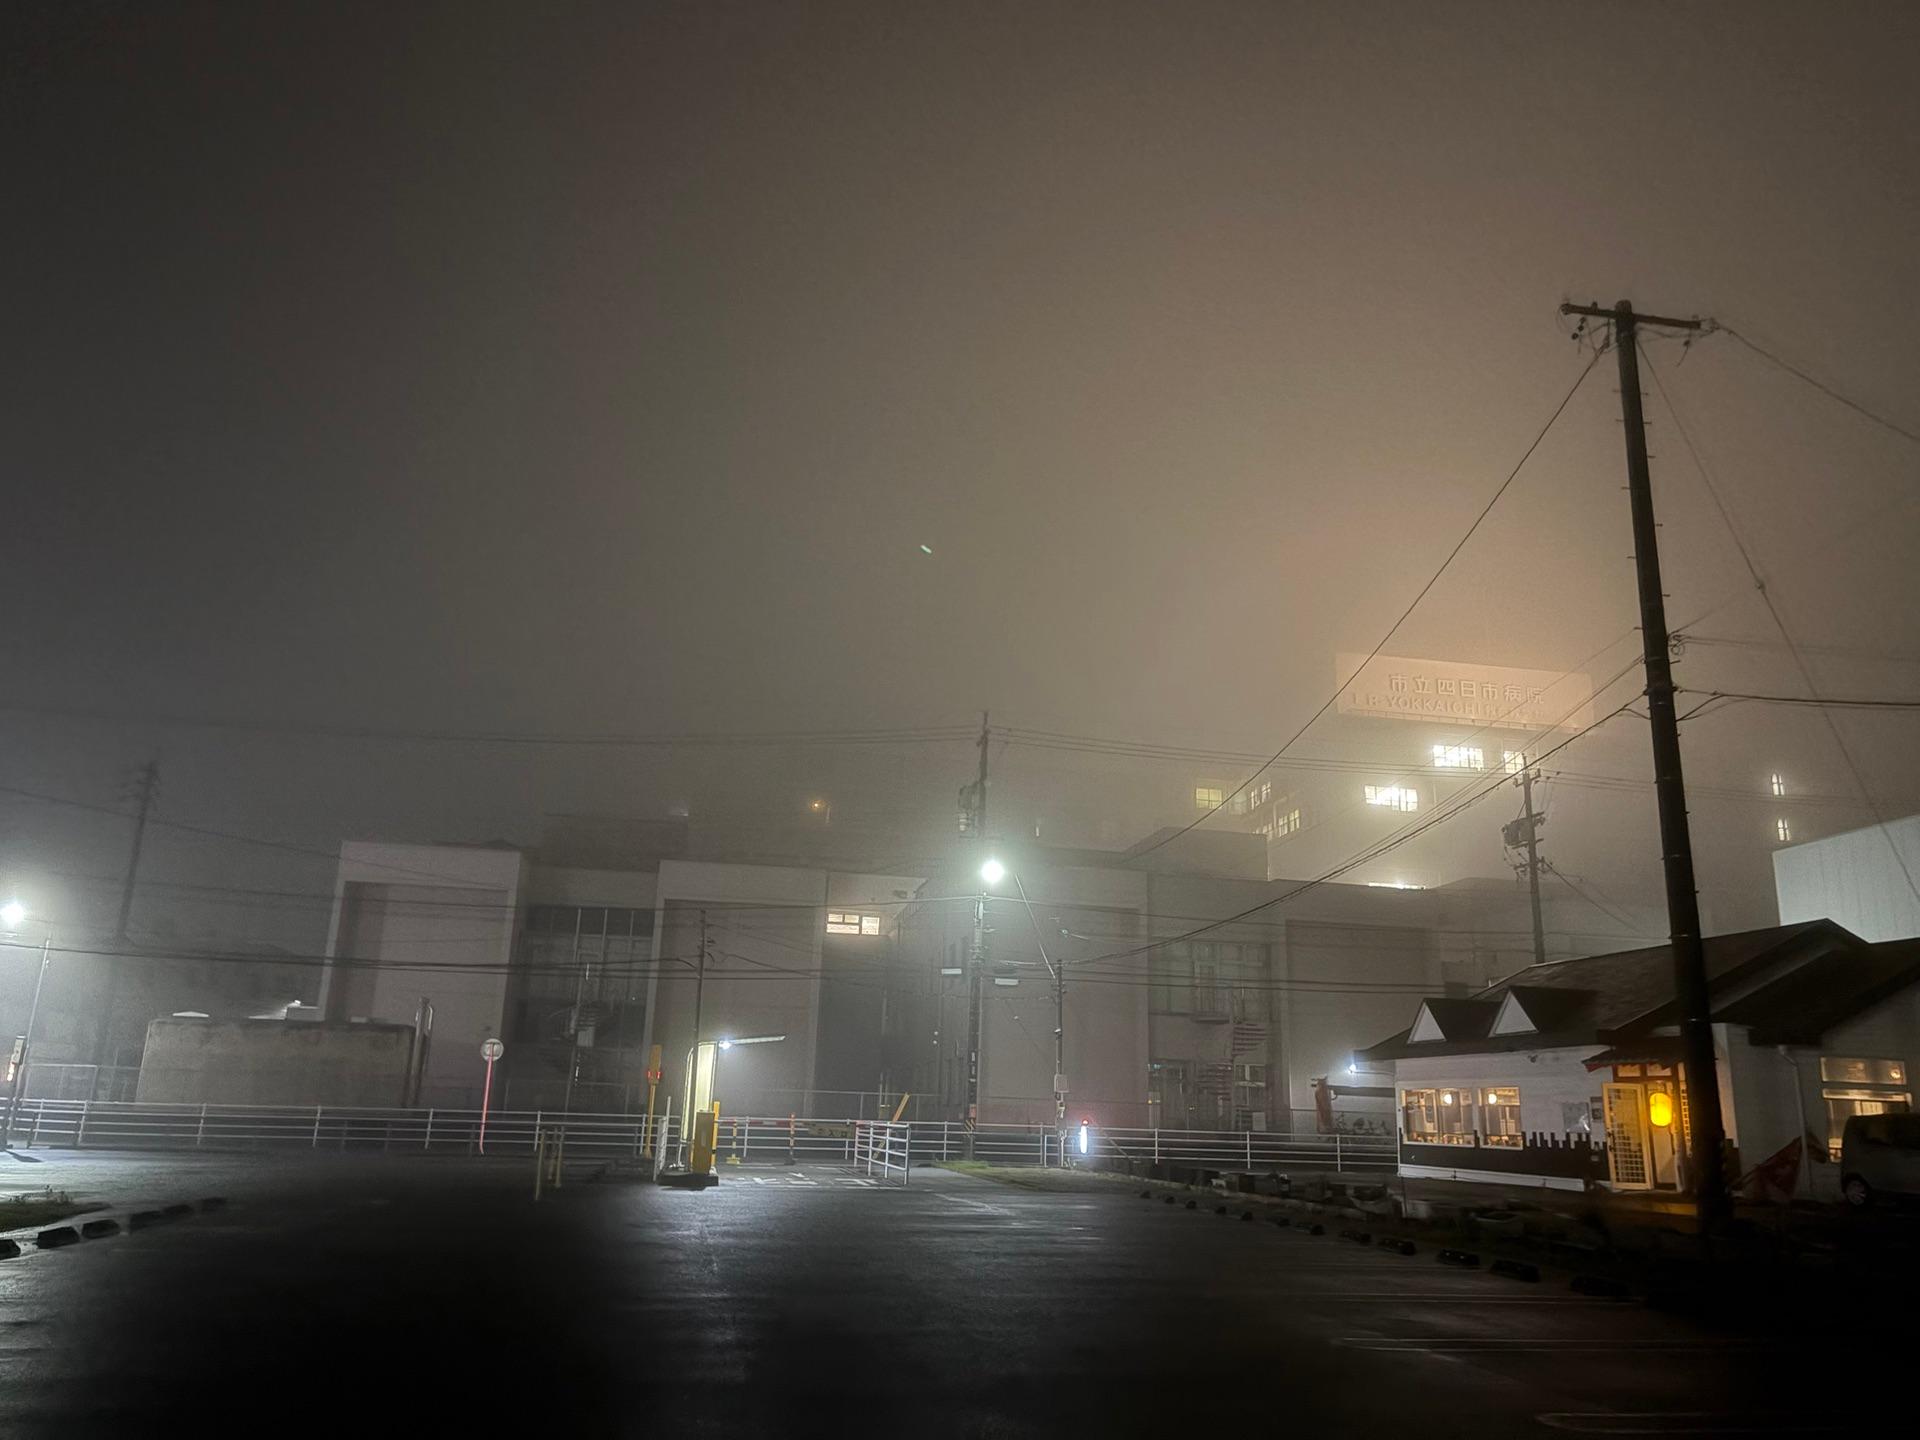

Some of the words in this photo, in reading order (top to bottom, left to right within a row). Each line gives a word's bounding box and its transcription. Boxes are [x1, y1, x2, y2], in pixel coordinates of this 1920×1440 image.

[1389, 673, 1545, 704] 市立四日市病院
[1389, 695, 1482, 716] YOKKAICHI
